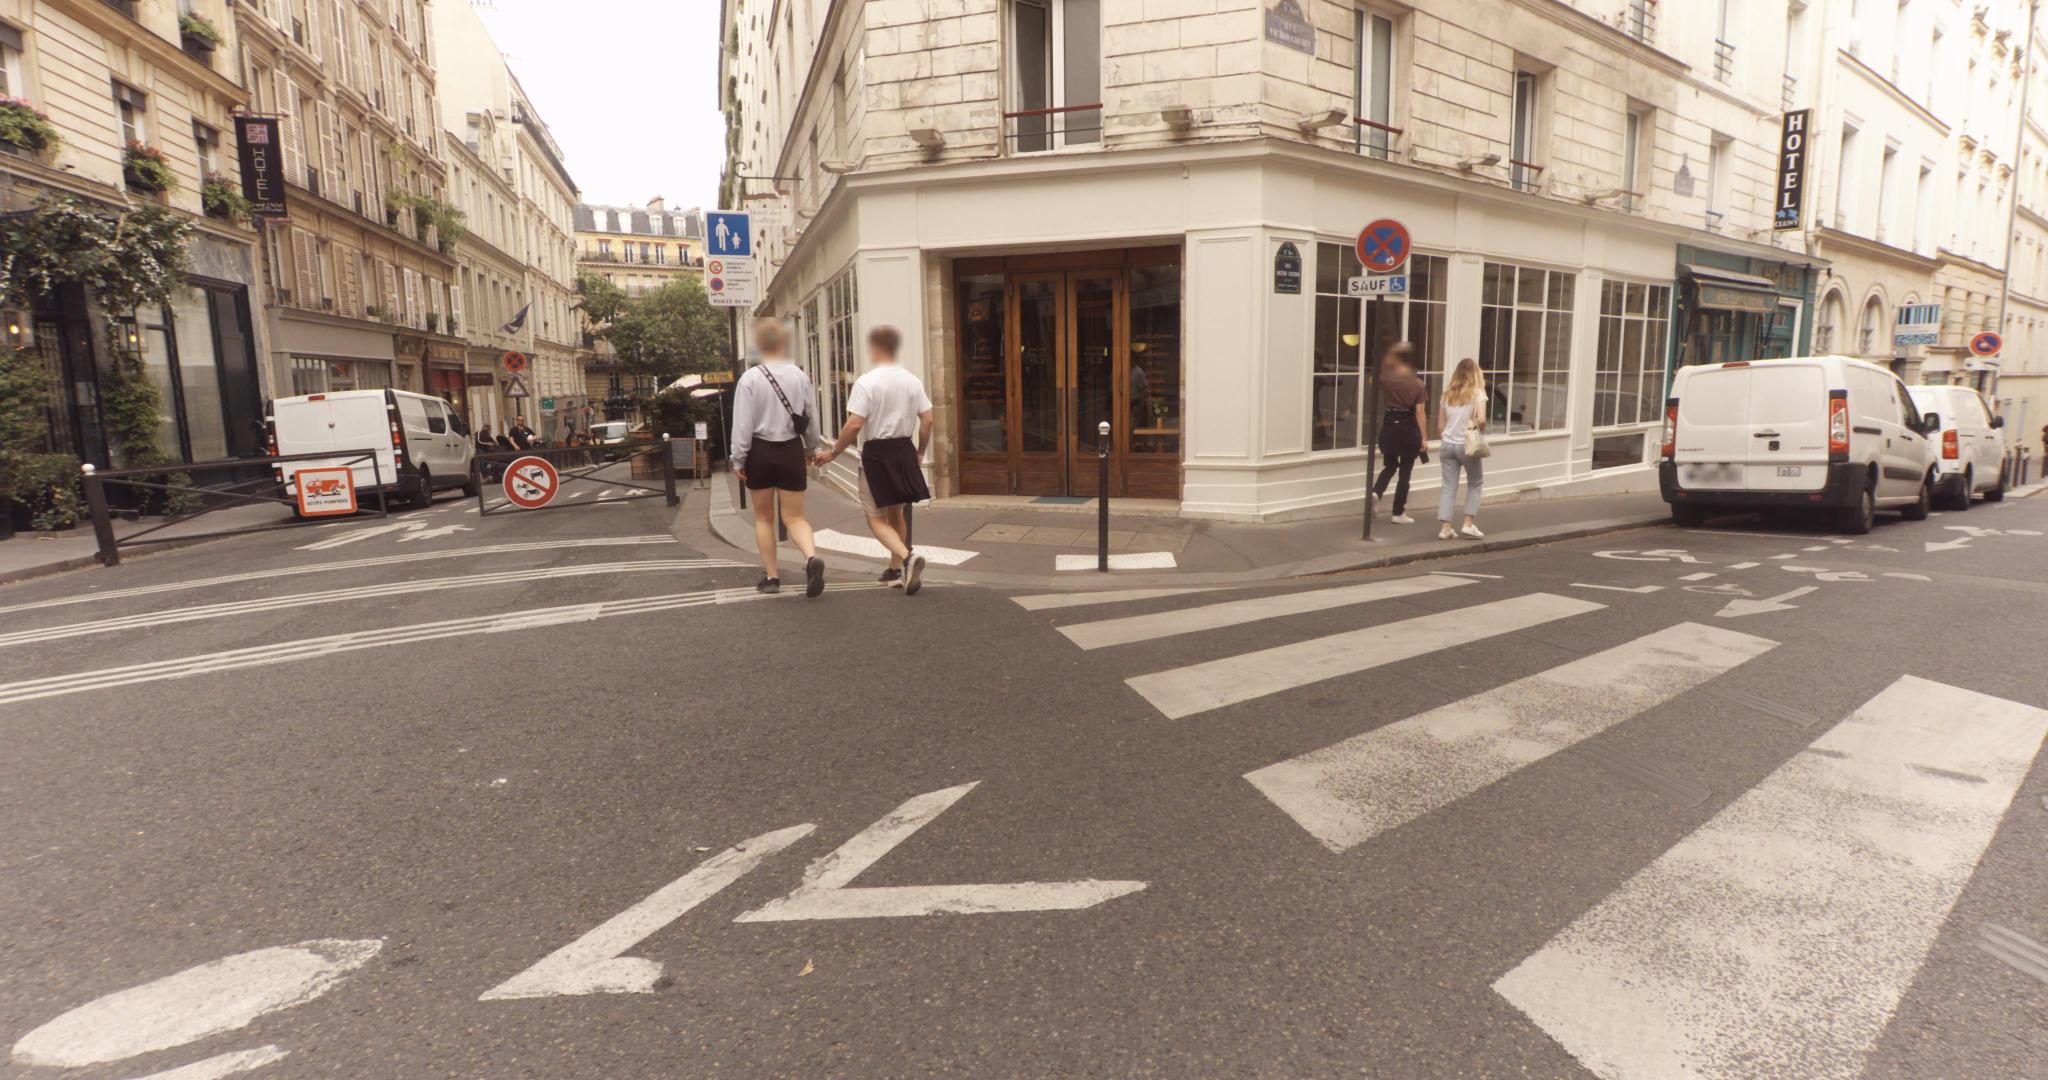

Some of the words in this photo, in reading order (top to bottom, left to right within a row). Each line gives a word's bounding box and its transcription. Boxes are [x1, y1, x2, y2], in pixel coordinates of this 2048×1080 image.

[252, 147, 270, 200] HOTEL
[1782, 113, 1804, 209] HOTEL
[1351, 280, 1386, 291] SAUF
